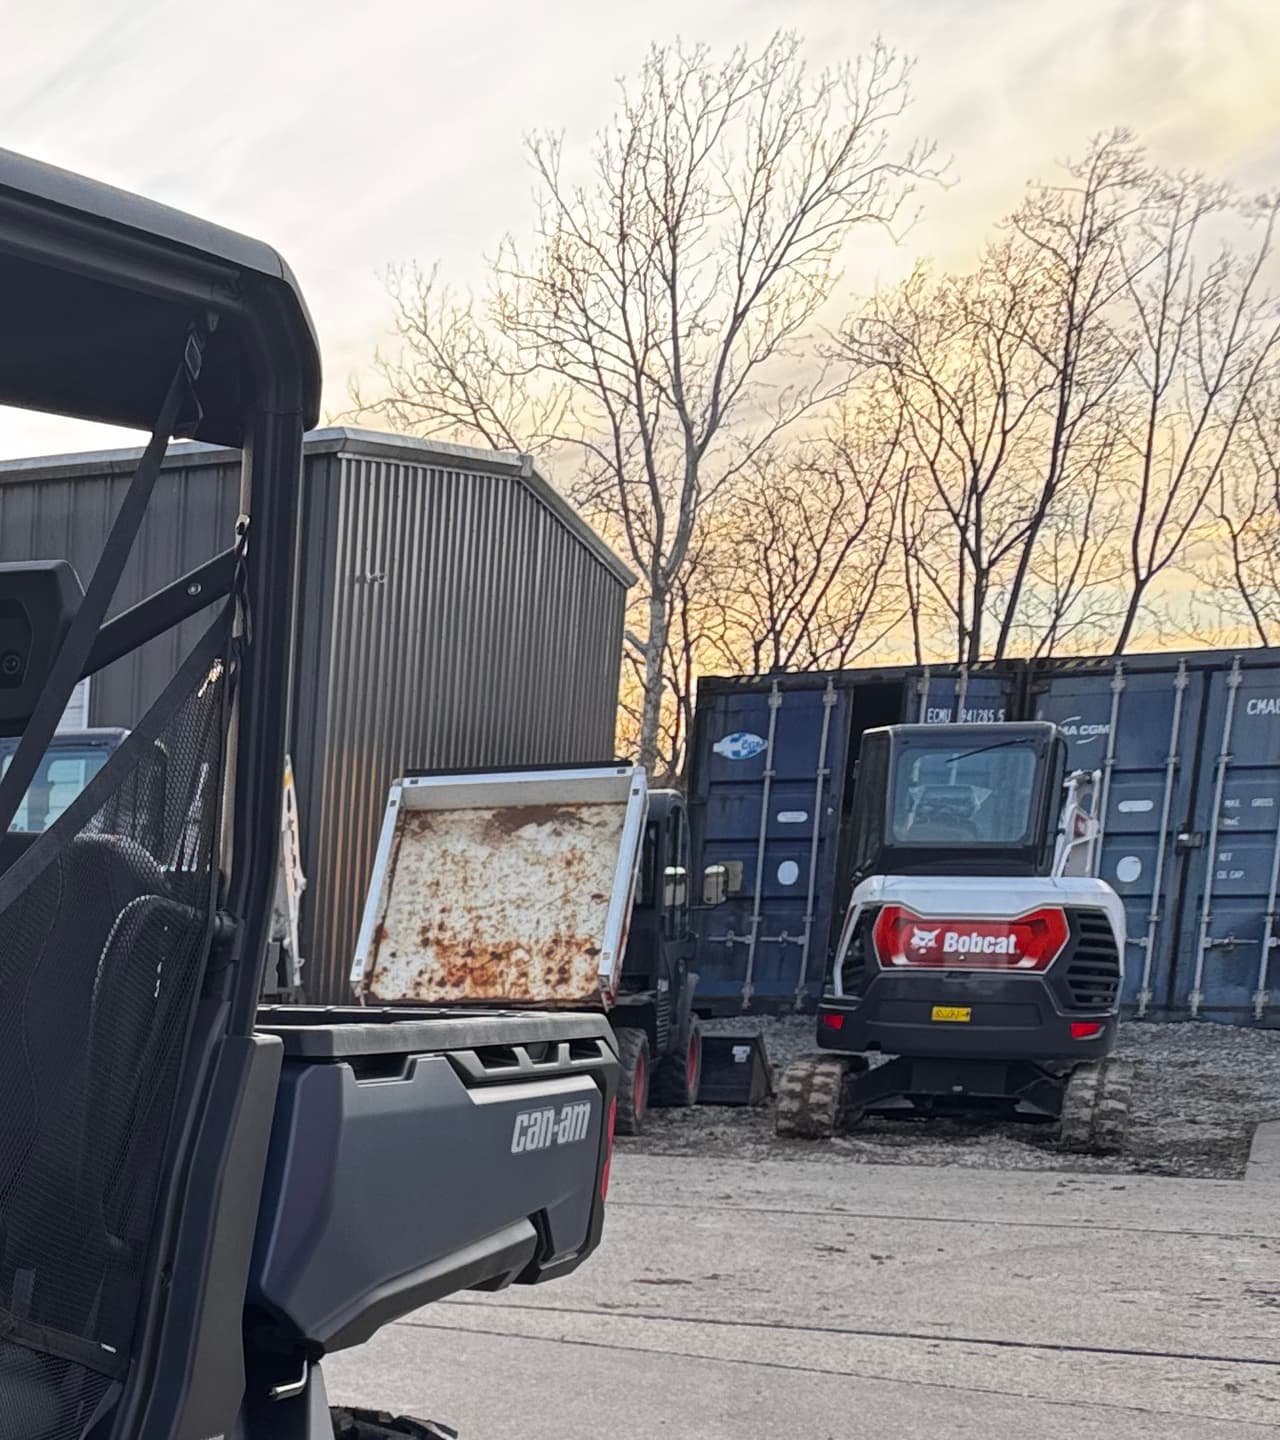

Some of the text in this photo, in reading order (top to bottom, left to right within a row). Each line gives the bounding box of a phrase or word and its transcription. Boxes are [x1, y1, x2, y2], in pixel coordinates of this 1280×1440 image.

[927, 708, 952, 723] ECMU
[1079, 724, 1112, 736] CGM
[943, 931, 1017, 954] Bobcat
[511, 1102, 591, 1154] can-am
